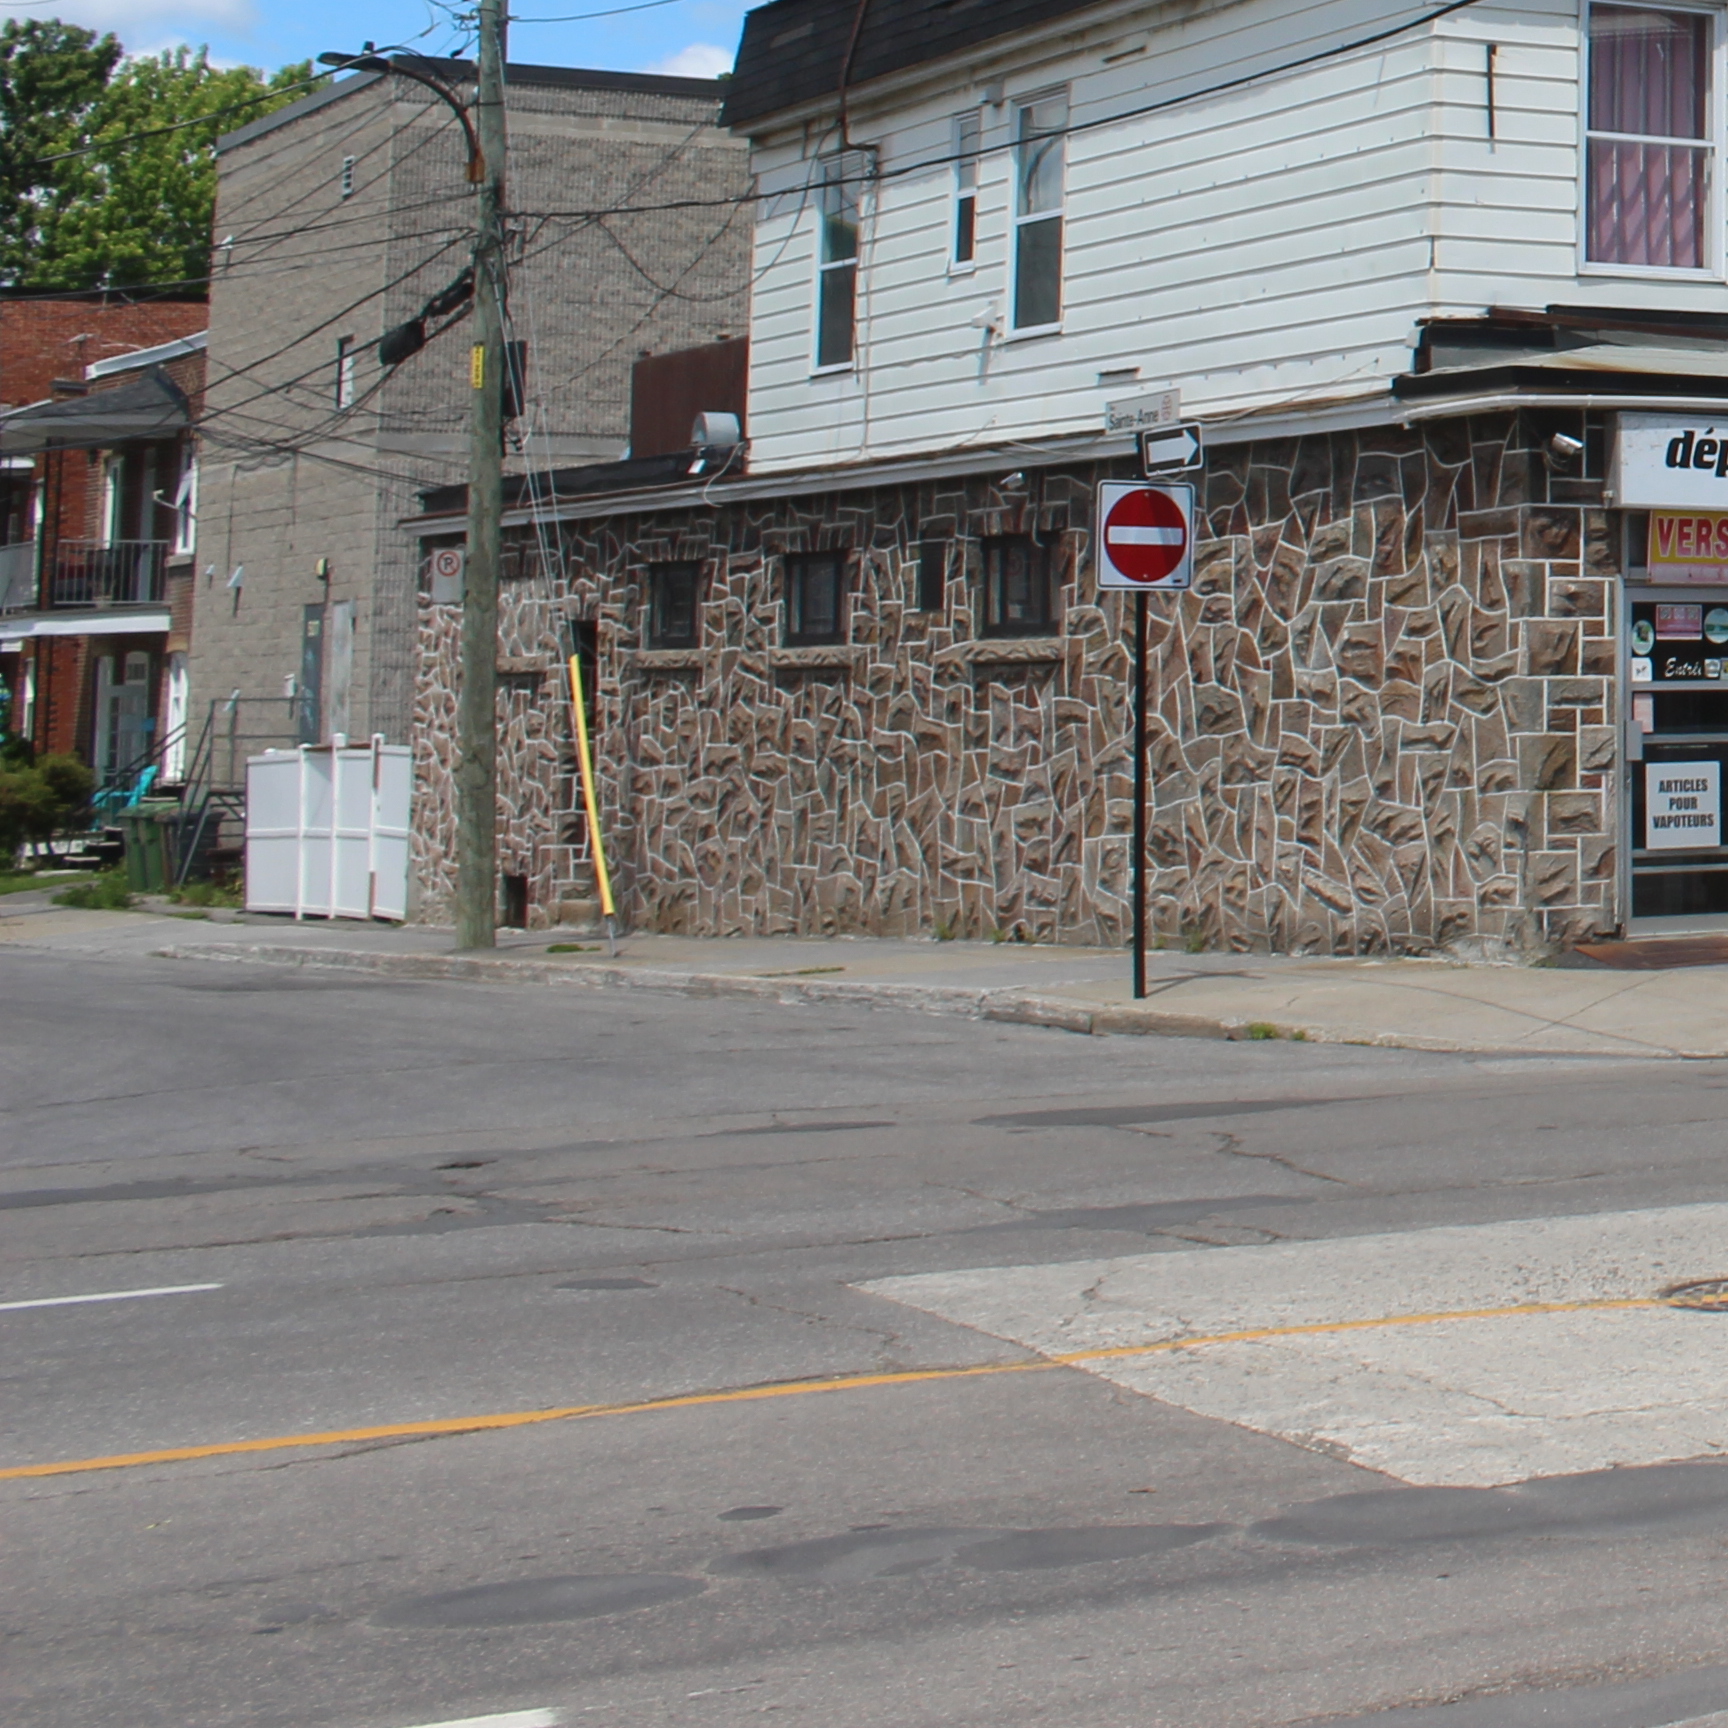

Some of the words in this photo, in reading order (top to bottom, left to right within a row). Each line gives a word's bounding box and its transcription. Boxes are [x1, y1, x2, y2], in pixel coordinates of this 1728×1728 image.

[1109, 408, 1160, 431] Sainte-Anne
[1658, 778, 1708, 793] ARTICLES
[1668, 796, 1698, 811] POUR
[1652, 813, 1715, 829] VAPOTEURS
